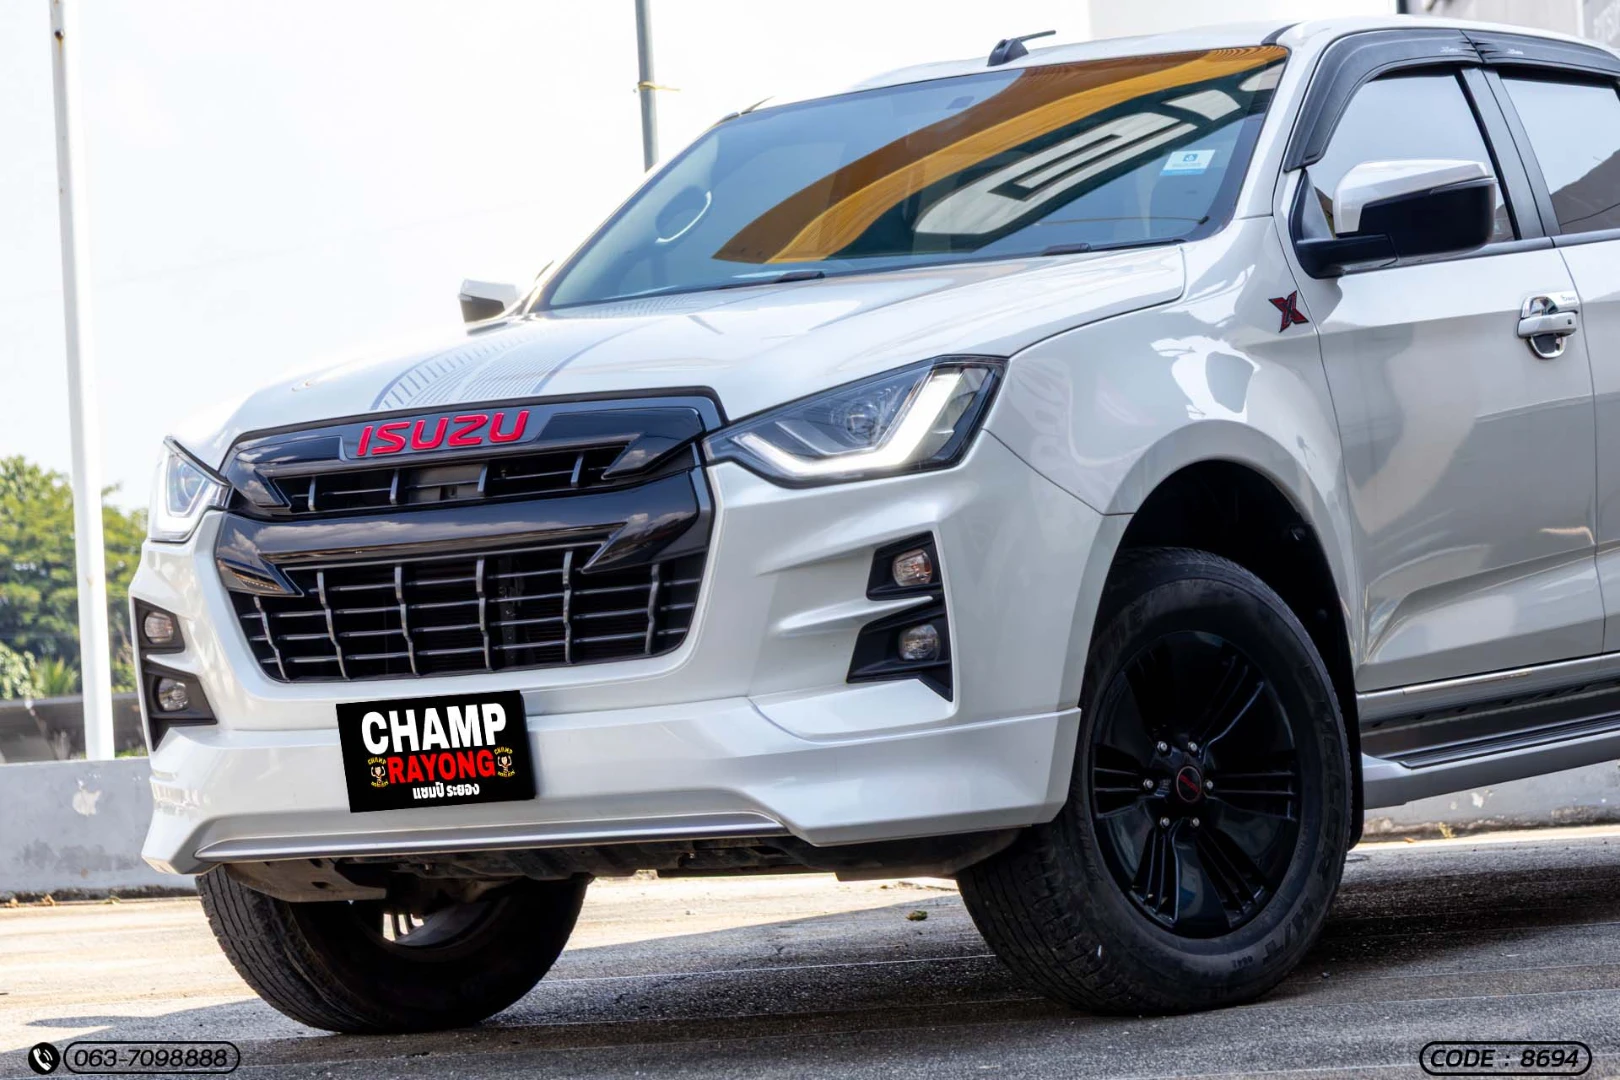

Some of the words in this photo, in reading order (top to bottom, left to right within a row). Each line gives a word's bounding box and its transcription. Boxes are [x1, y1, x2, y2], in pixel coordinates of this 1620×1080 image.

[356, 410, 530, 457] ISUZU
[361, 703, 507, 755] CHAMP
[387, 749, 495, 784] RAYONG
[446, 783, 480, 797] ระยอง
